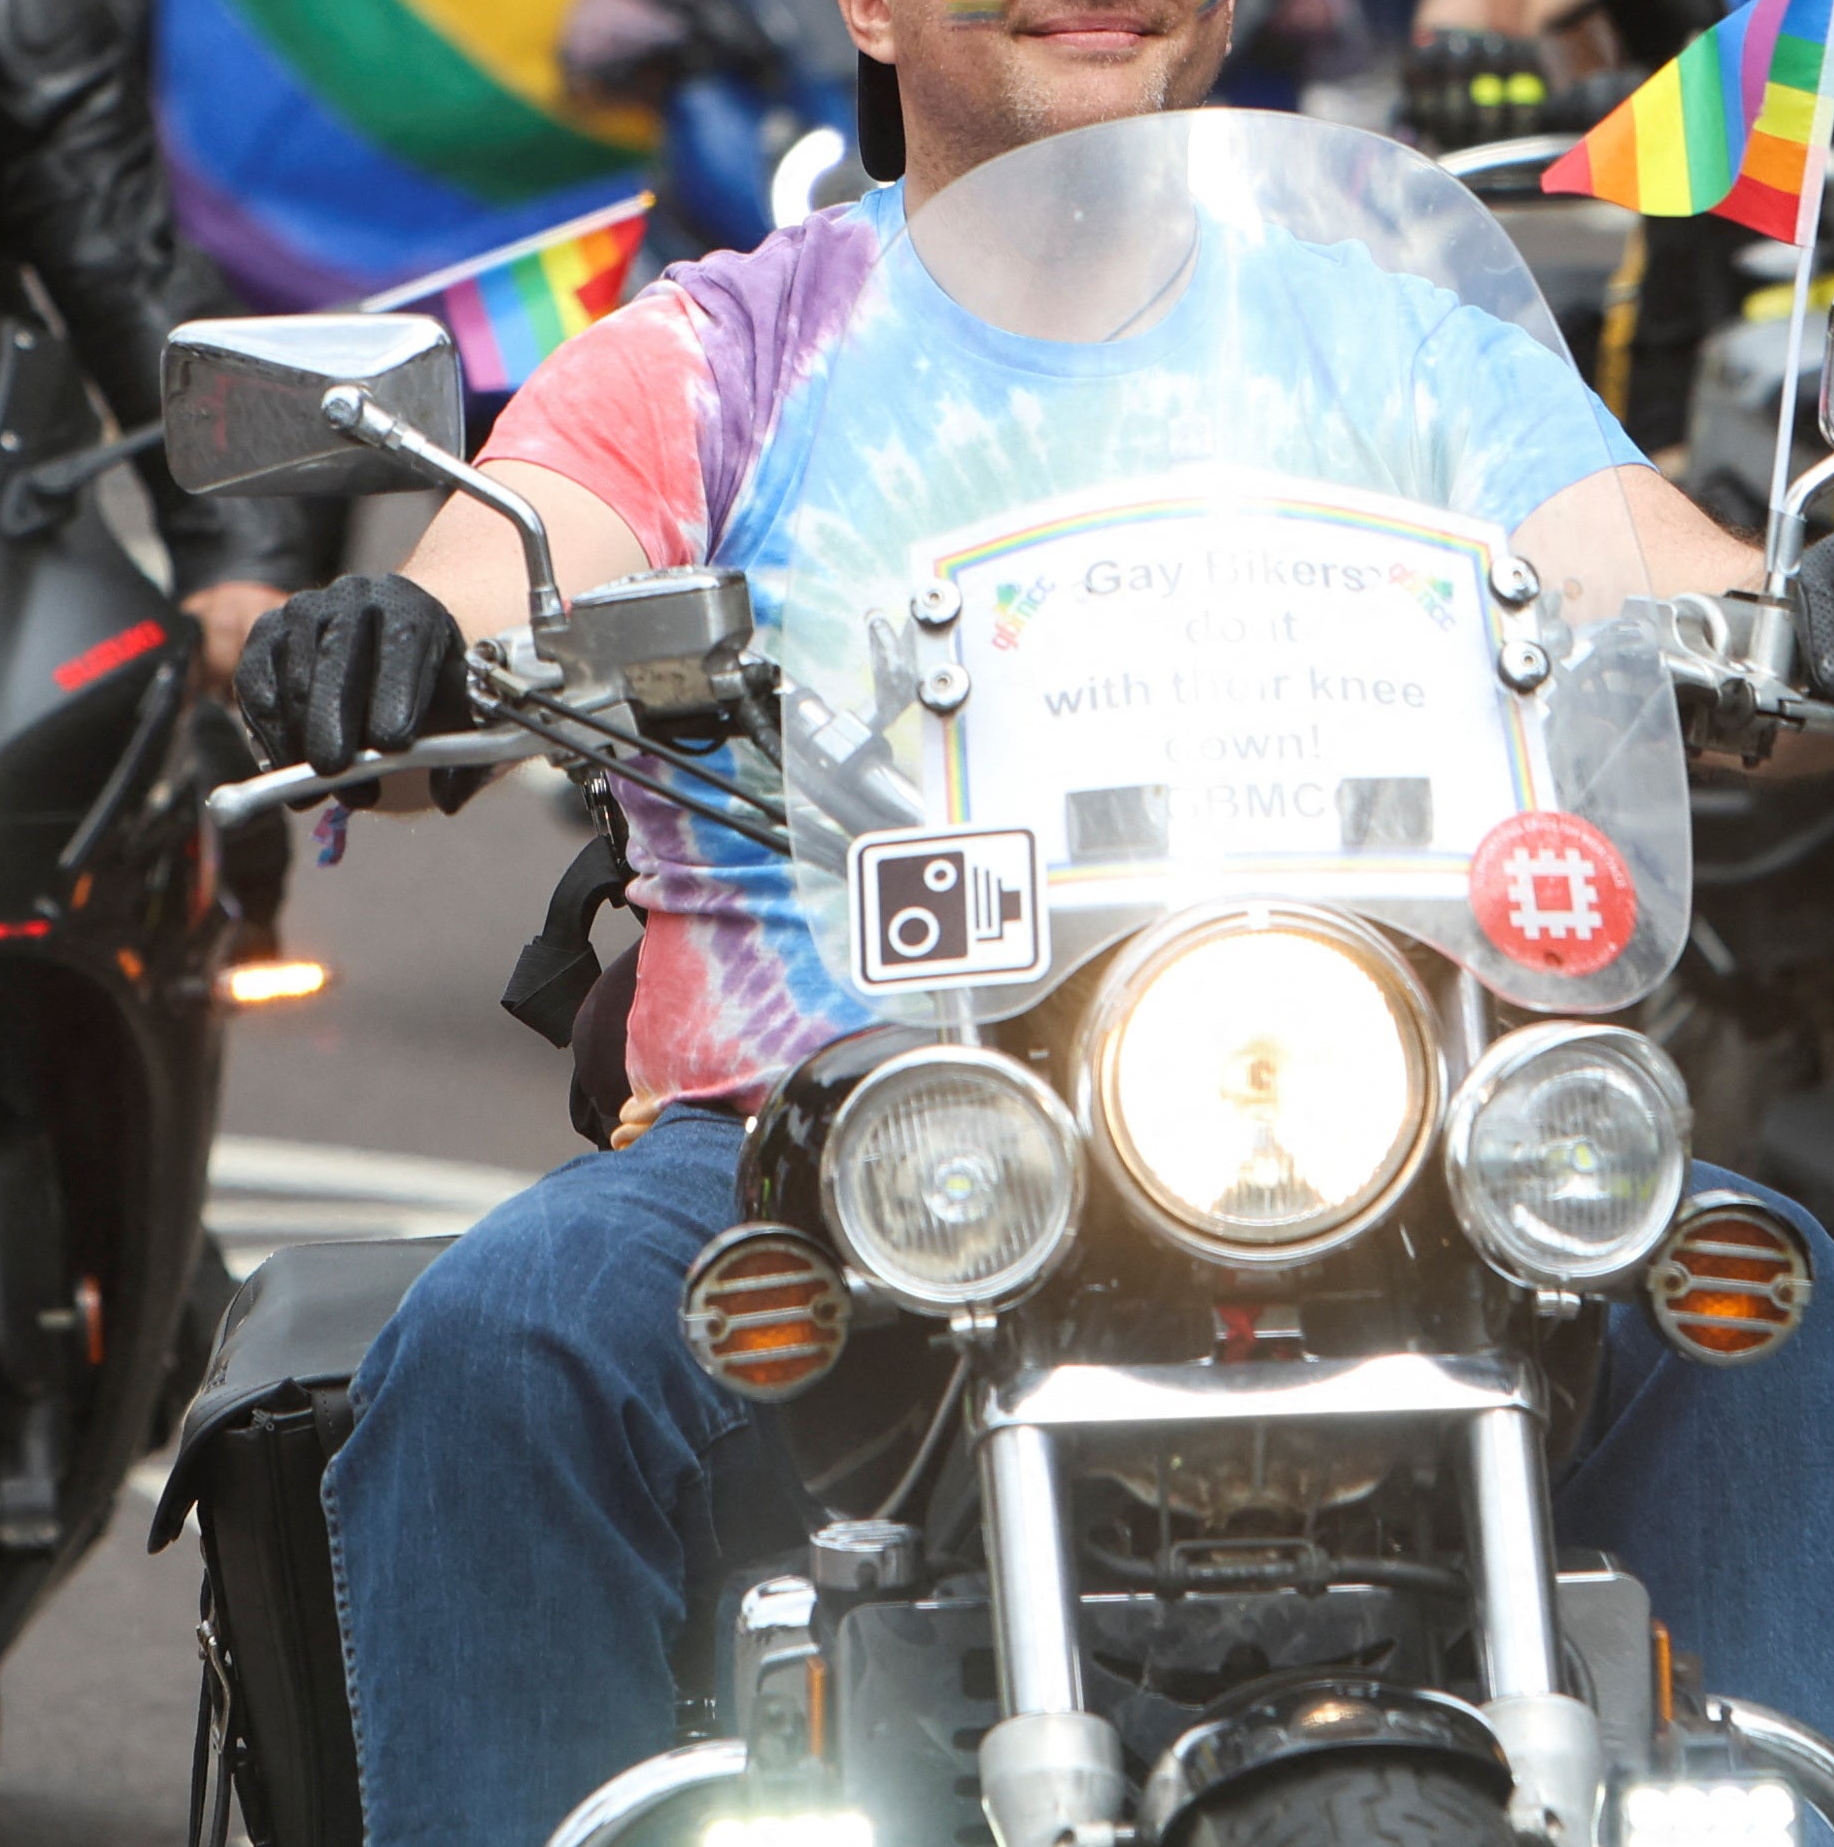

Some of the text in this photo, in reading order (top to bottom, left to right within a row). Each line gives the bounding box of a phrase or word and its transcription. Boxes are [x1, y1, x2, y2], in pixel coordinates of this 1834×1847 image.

[1085, 548, 1367, 598] Gay Bikers
[1185, 609, 1298, 644] do it
[1044, 665, 1427, 718] with their knee
